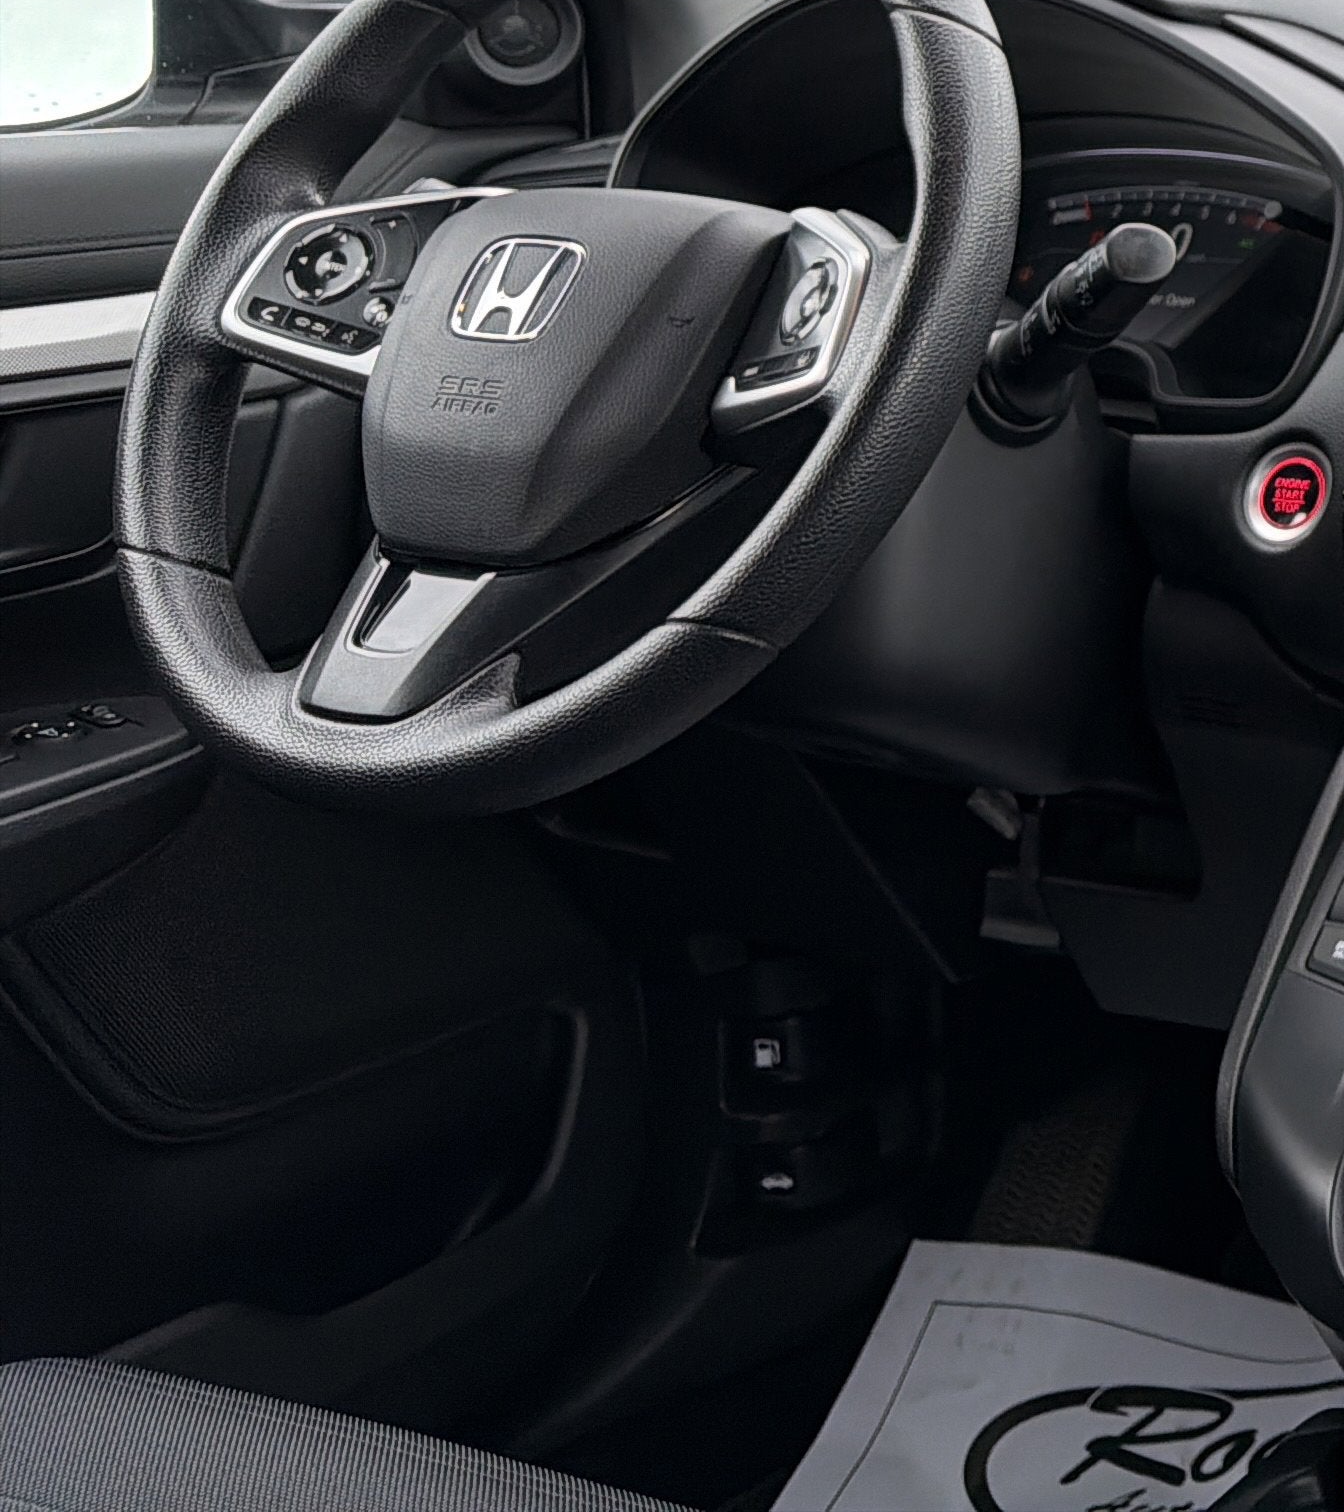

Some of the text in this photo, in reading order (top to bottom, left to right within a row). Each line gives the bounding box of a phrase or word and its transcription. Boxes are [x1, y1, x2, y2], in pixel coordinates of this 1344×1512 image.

[438, 374, 505, 395] SRS
[1275, 476, 1312, 490] ENGINE
[1275, 488, 1306, 500] START
[1274, 500, 1300, 513] STOP
